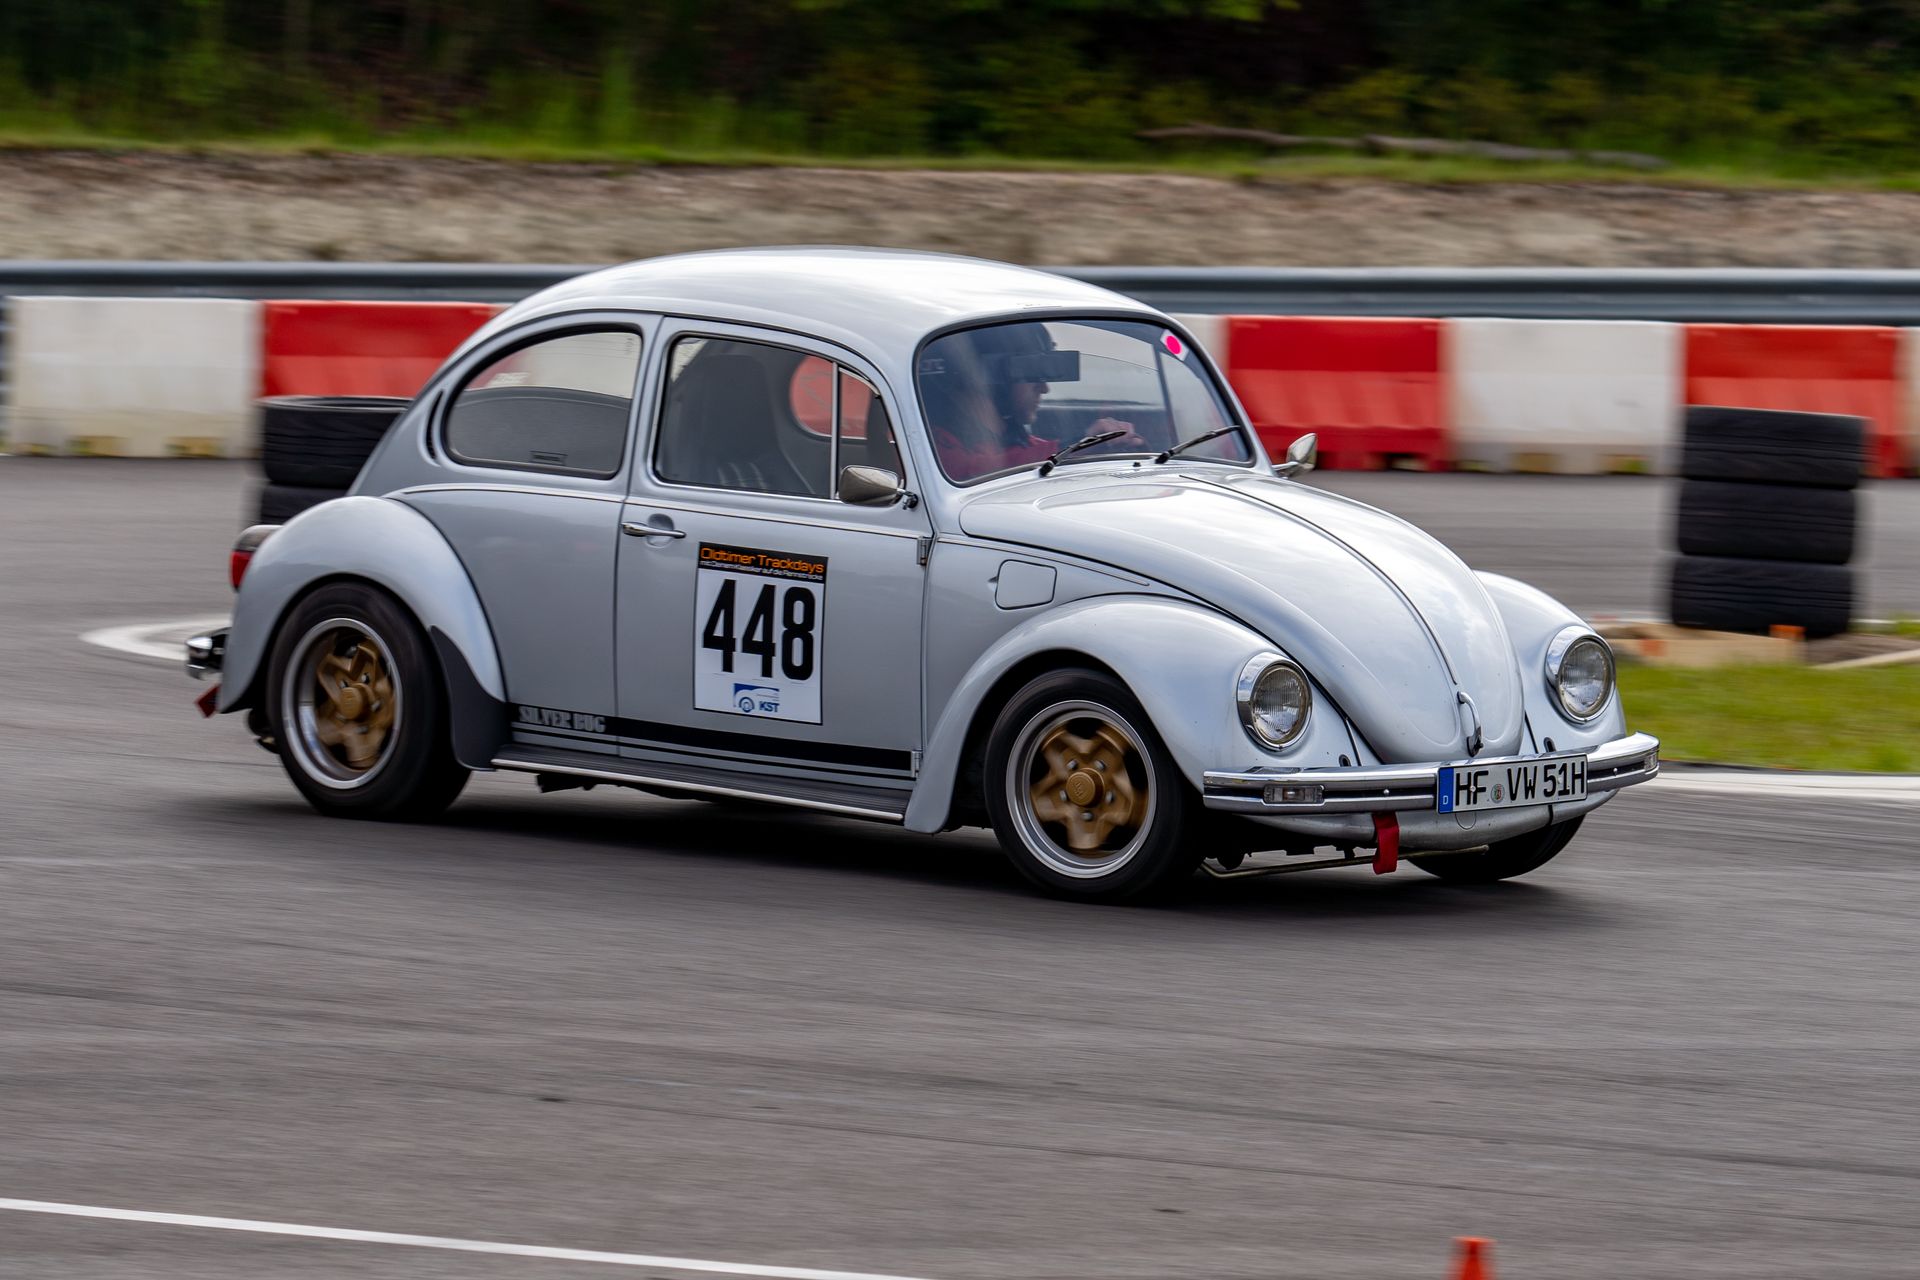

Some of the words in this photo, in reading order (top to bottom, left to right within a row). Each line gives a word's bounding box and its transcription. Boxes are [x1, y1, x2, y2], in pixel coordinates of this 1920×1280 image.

[700, 548, 755, 564] Oldtimer
[757, 555, 824, 574] Trackdays
[703, 579, 815, 681] 448
[519, 706, 572, 728] SILVER
[759, 701, 780, 713] KST
[1443, 795, 1448, 805] D
[1455, 770, 1489, 806] HF
[1507, 766, 1538, 801] VW
[1543, 761, 1585, 797] 51H
